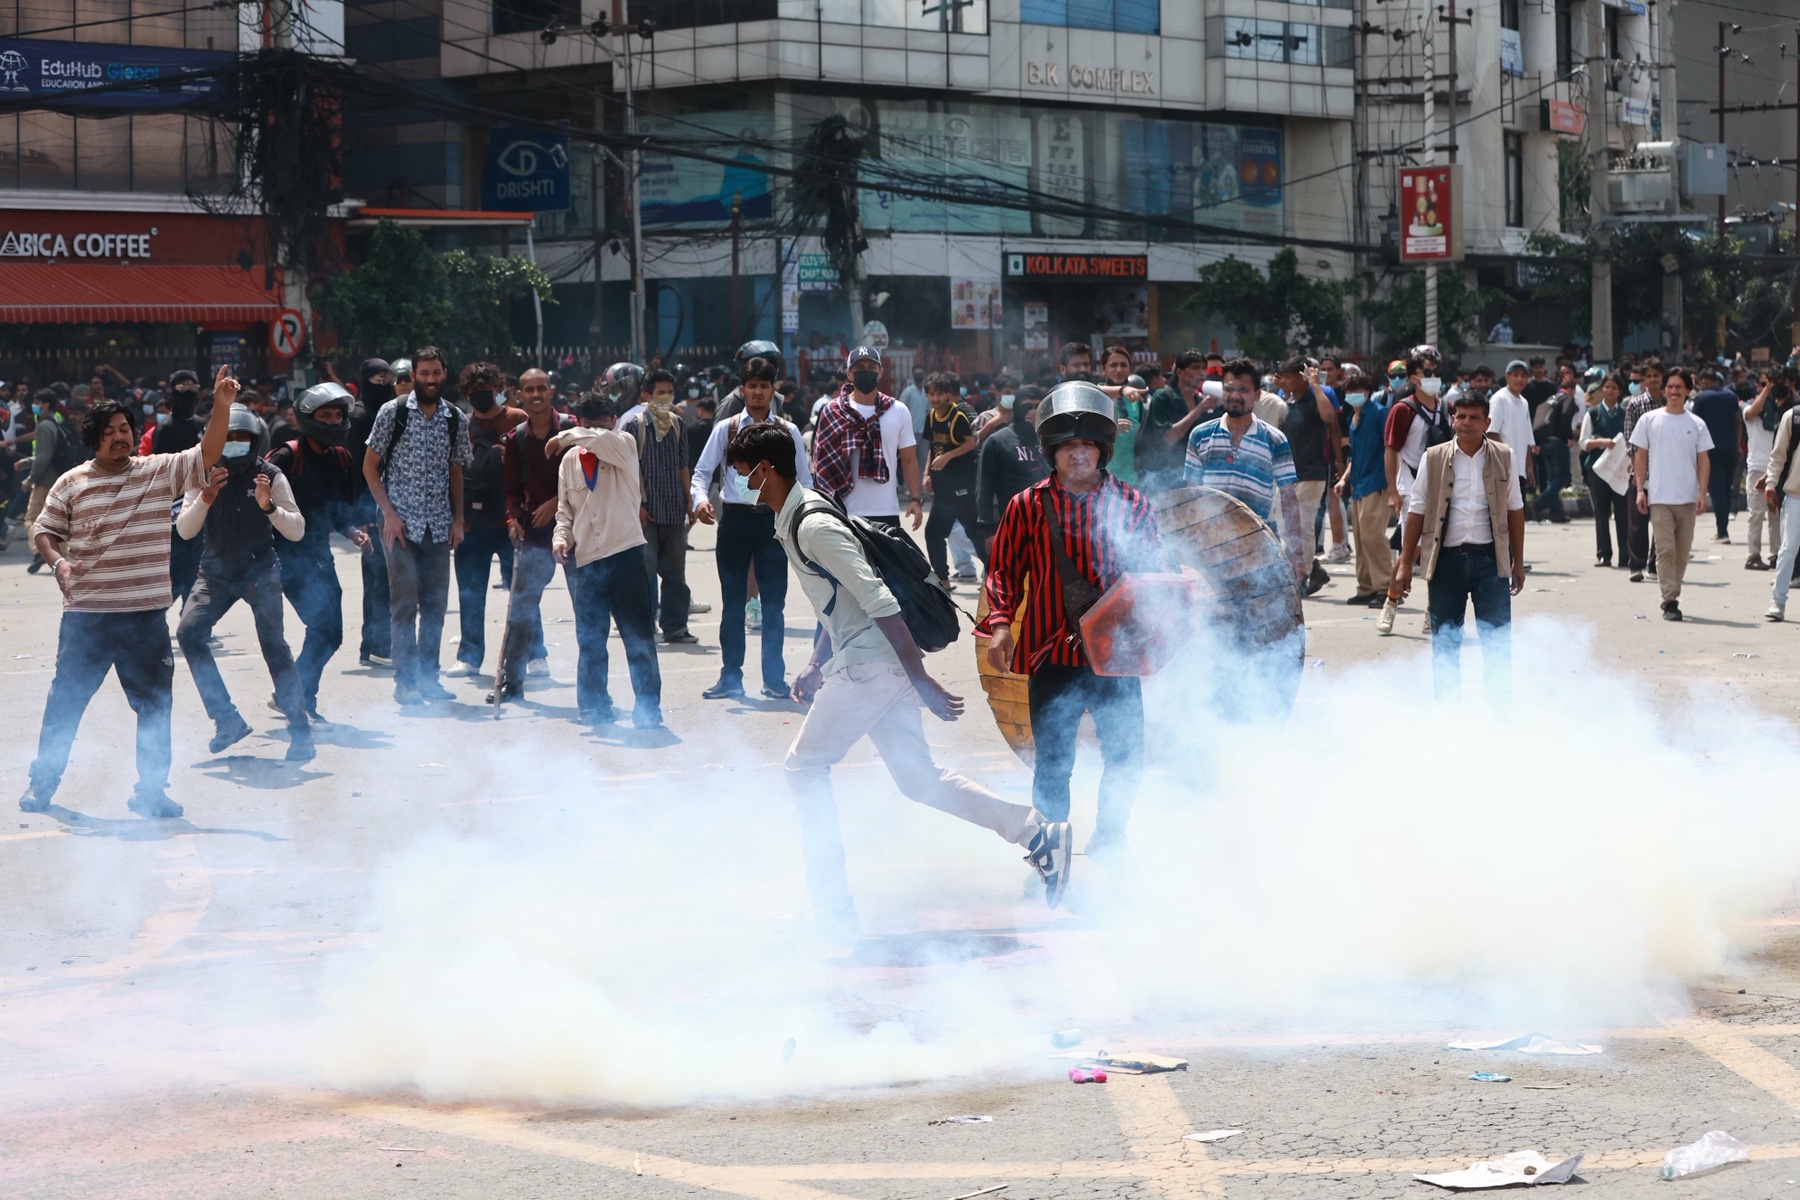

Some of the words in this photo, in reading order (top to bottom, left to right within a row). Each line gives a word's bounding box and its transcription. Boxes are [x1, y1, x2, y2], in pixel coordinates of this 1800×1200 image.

[41, 59, 102, 78] EduHub
[1027, 61, 1059, 87] B.K
[1069, 65, 1155, 94] COMPLEX
[41, 78, 86, 89] EDUCATION
[1053, 118, 1070, 142] E
[937, 135, 966, 159] EYE
[969, 136, 1030, 162] CENTER
[1241, 143, 1277, 156] DIABETES
[496, 178, 555, 199] DRISHTI
[73, 233, 151, 257] COFFEE
[1026, 254, 1089, 276] KOLKATA
[1089, 256, 1146, 277] SWEETS
[279, 319, 298, 347] P
